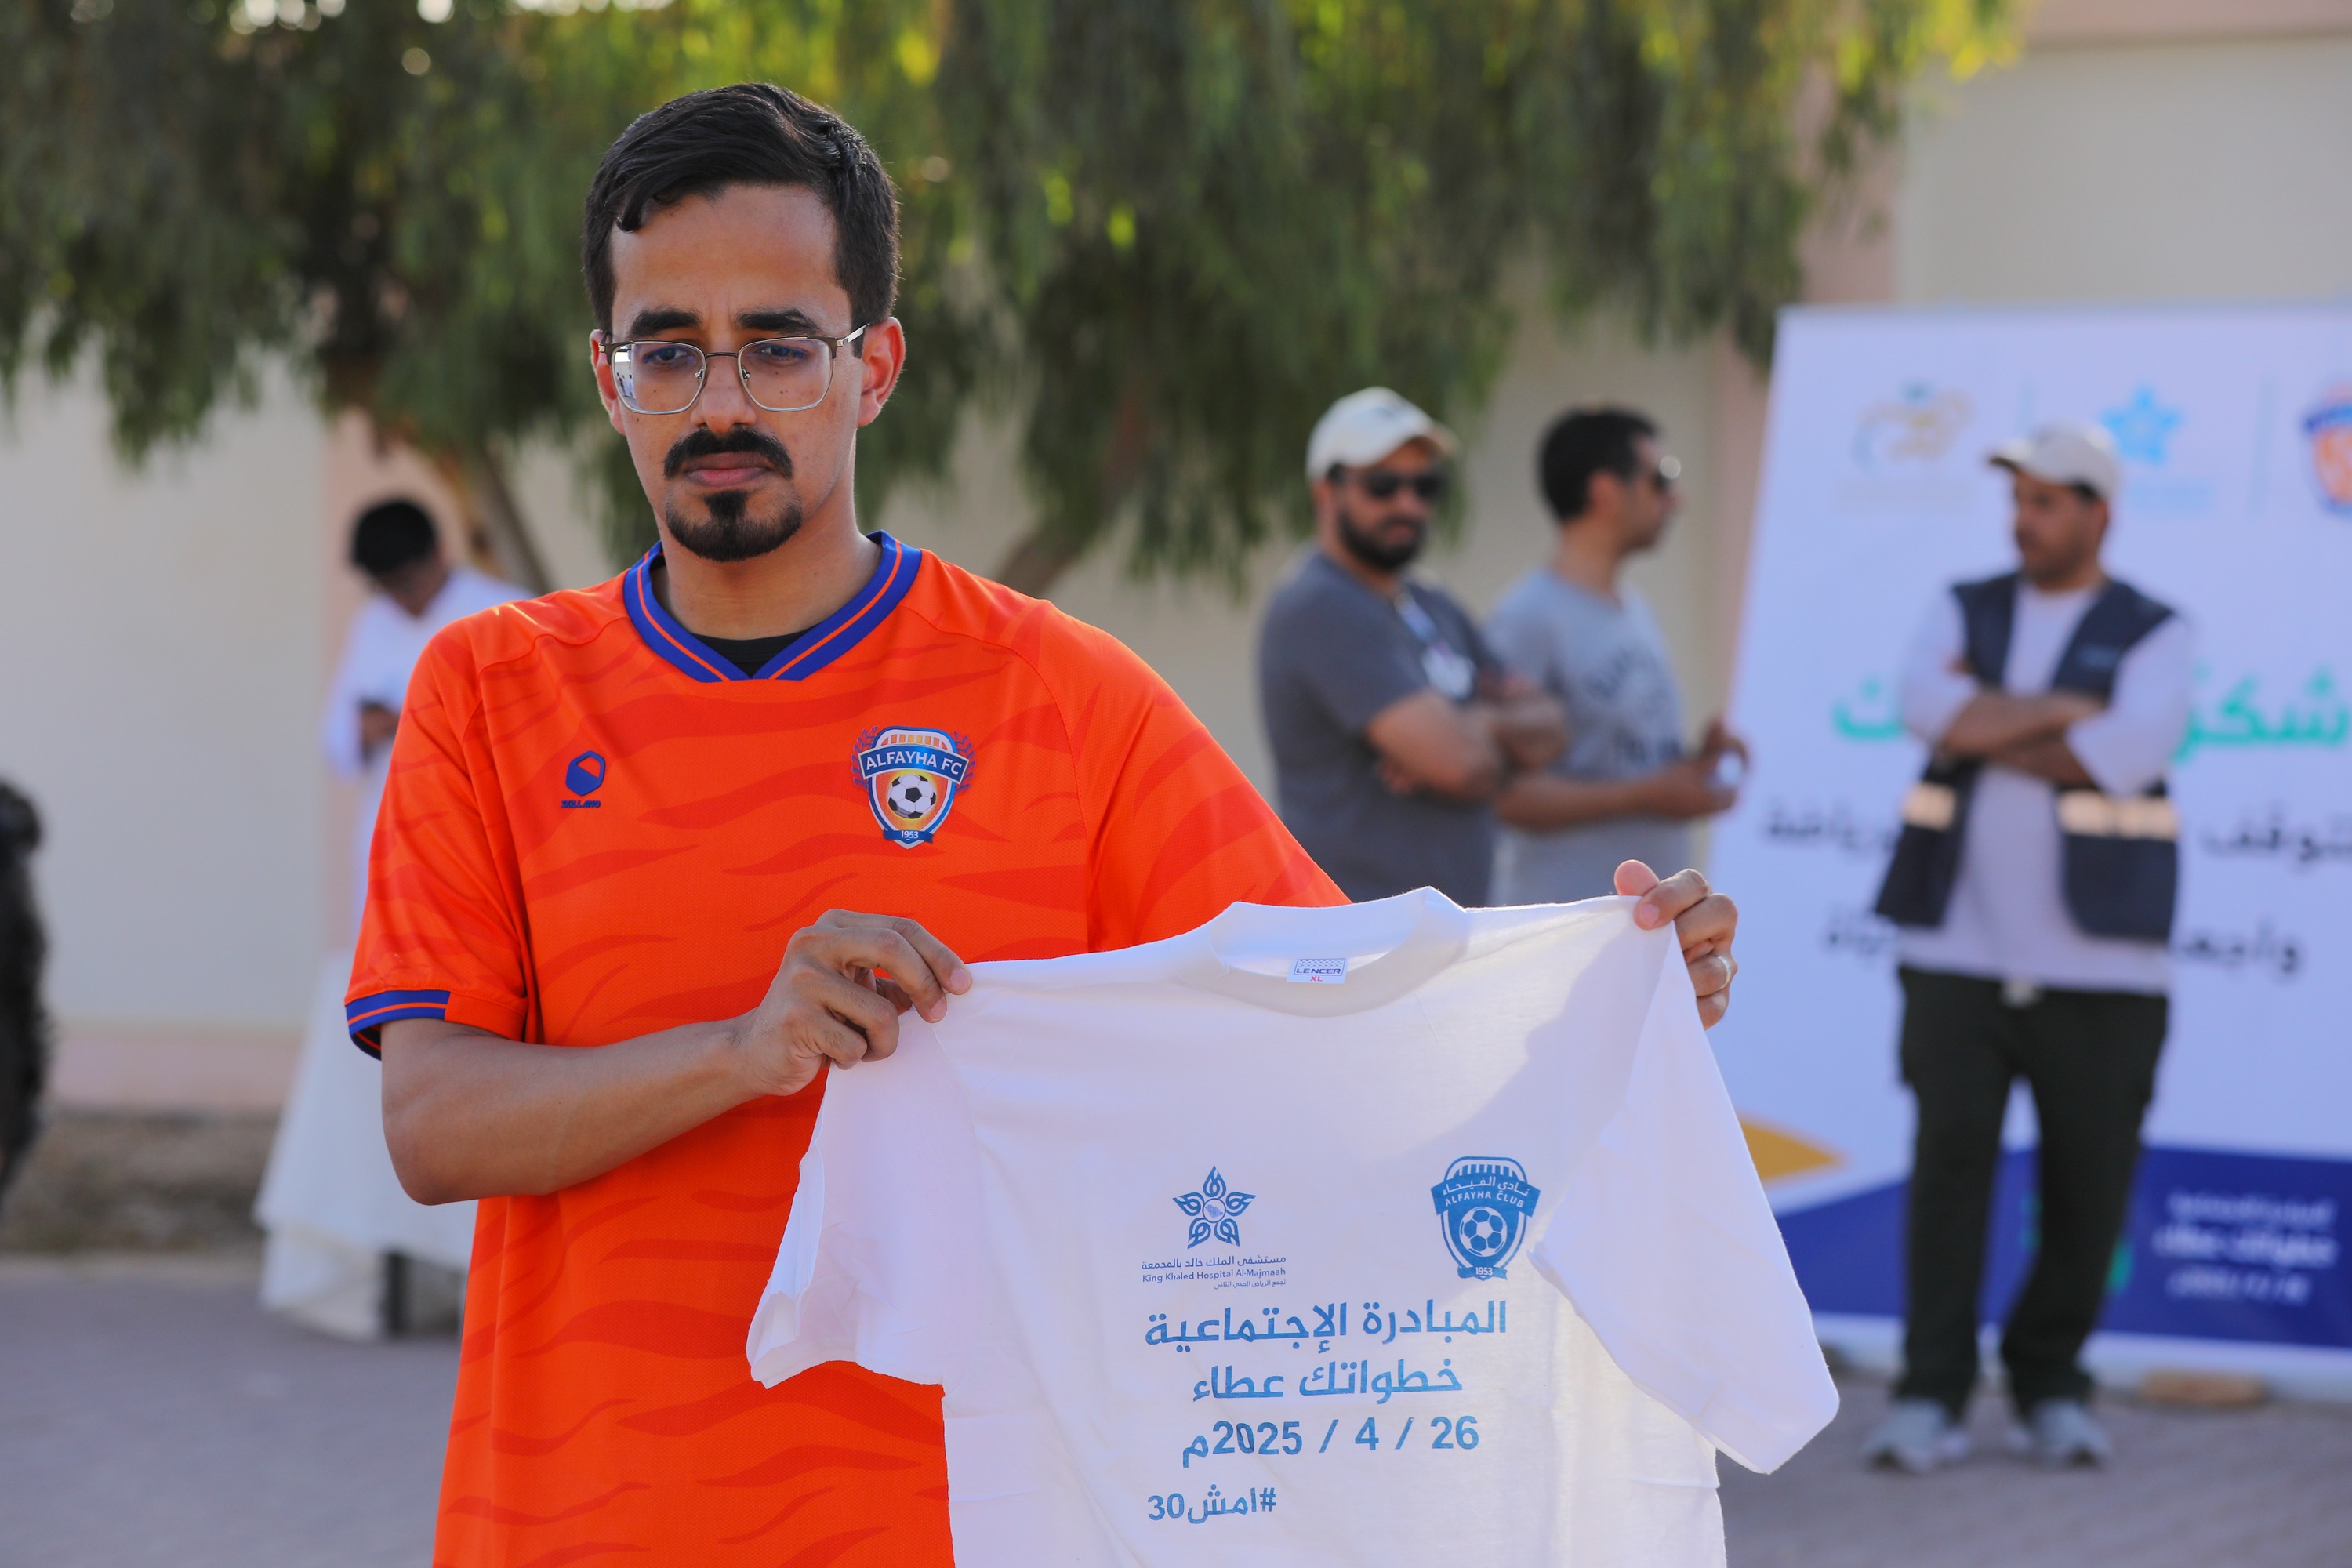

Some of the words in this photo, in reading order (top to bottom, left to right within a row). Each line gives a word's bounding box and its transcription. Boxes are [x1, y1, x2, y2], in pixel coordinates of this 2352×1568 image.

[866, 750, 937, 770] ALFAYHA
[941, 757, 963, 775] FC
[901, 830, 919, 839] 1953
[1443, 1176, 1496, 1196] الفيحاء
[1497, 1181, 1530, 1196] نادي
[1445, 1191, 1492, 1207] ALFAYHA
[1496, 1192, 1525, 1208] CLUB
[1142, 1258, 1182, 1269] بالمجمعة
[1185, 1258, 1203, 1268] خالد
[1206, 1256, 1234, 1266] الملك
[1237, 1255, 1286, 1266] مستشفى
[1142, 1274, 1163, 1283] King
[1165, 1272, 1194, 1280] Khaled
[1196, 1269, 1233, 1279] Hospital
[1236, 1267, 1286, 1278] Al-Majmaah
[1475, 1266, 1494, 1276] 1953
[1145, 1302, 1347, 1354] الإجتماعية
[1363, 1299, 1507, 1345] المبادرة
[1192, 1365, 1284, 1402] عطاء
[1298, 1358, 1463, 1404] خطواتك
[1355, 1417, 1380, 1450] 4
[1431, 1415, 1479, 1450] 26
